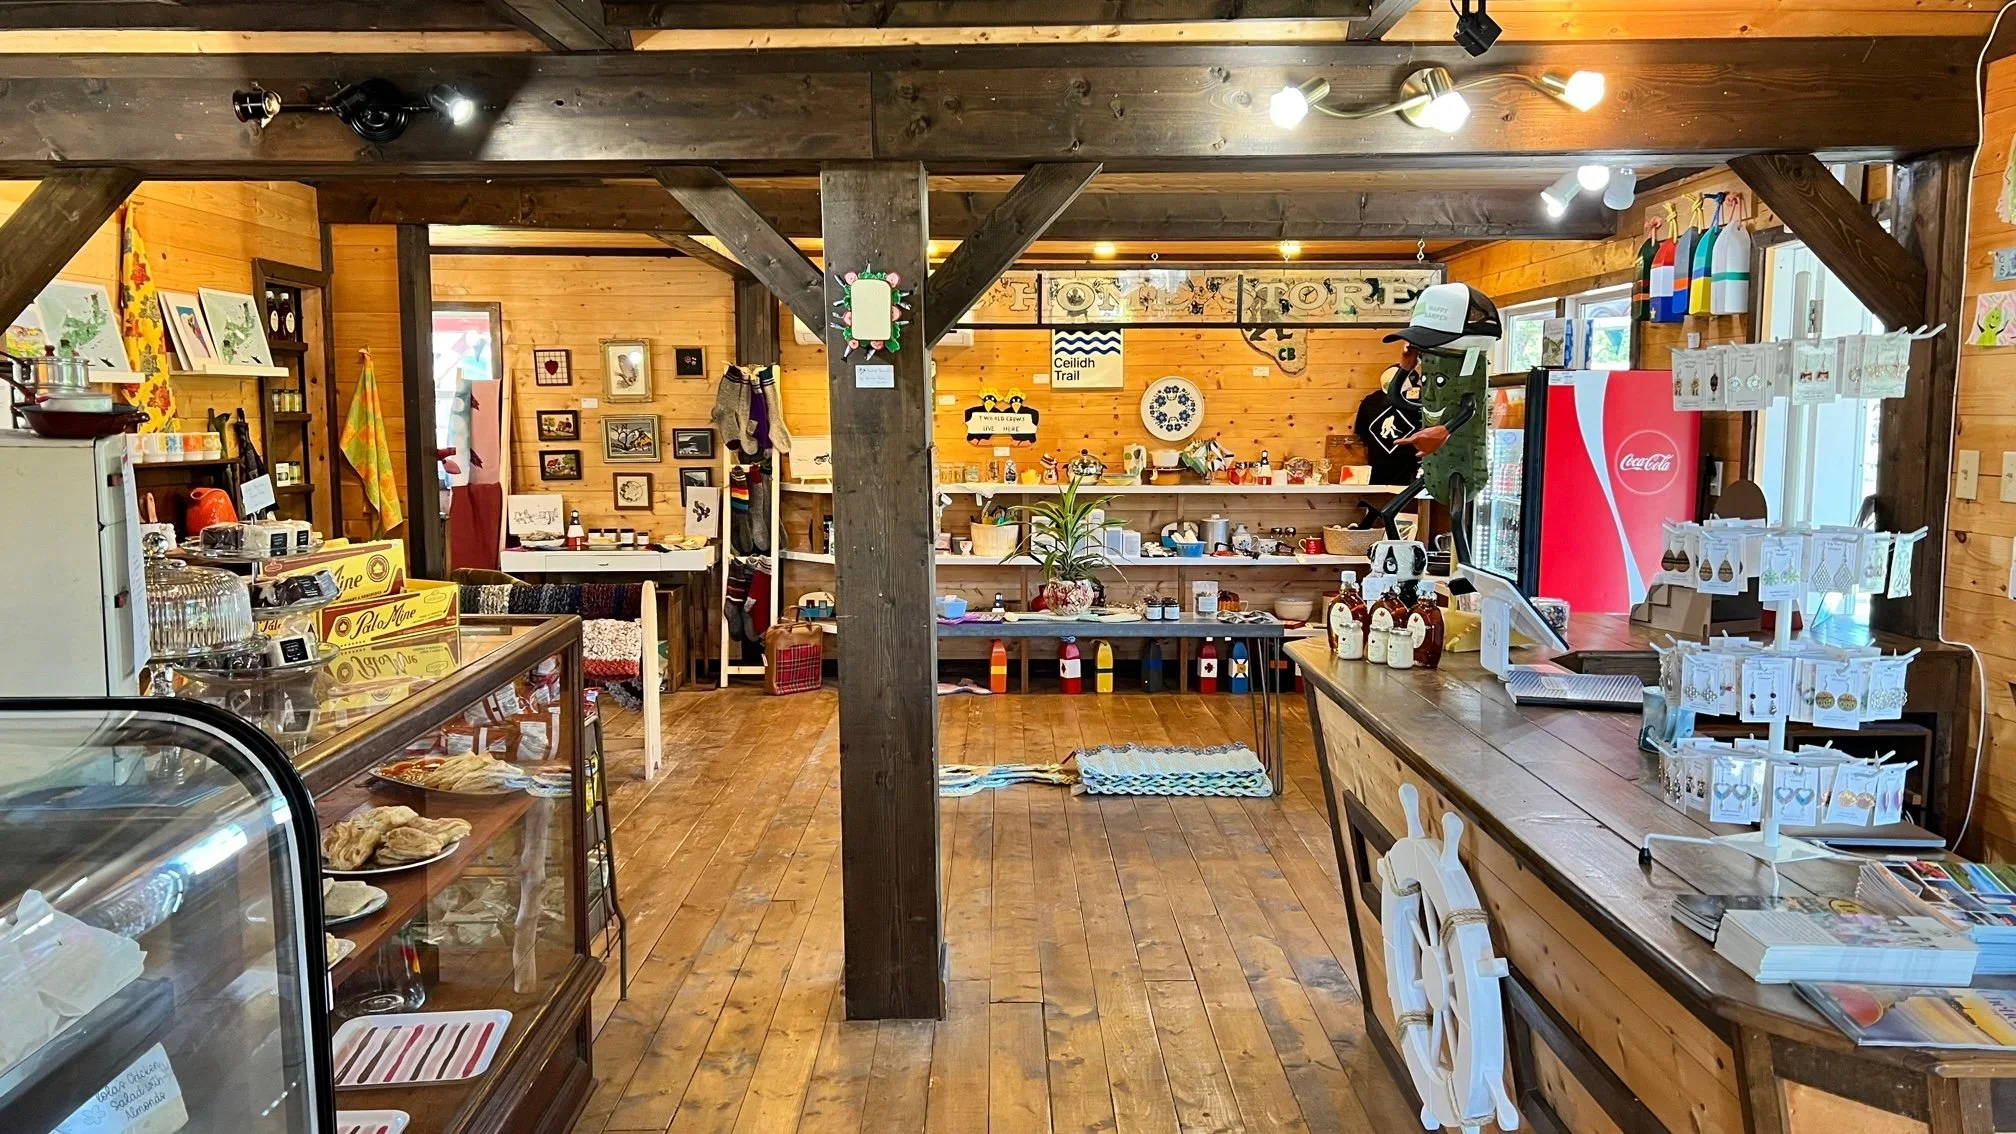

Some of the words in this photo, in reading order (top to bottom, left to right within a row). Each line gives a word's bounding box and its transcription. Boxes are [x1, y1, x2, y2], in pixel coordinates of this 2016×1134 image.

[1278, 347, 1296, 361] CB
[1053, 357, 1095, 368] Ceilidh
[1054, 370, 1080, 381] Trail
[1620, 453, 1675, 471] Coca-Cola
[110, 1087, 145, 1111] Salad
[144, 1076, 164, 1094] with
[125, 1091, 166, 1121] Almonds
